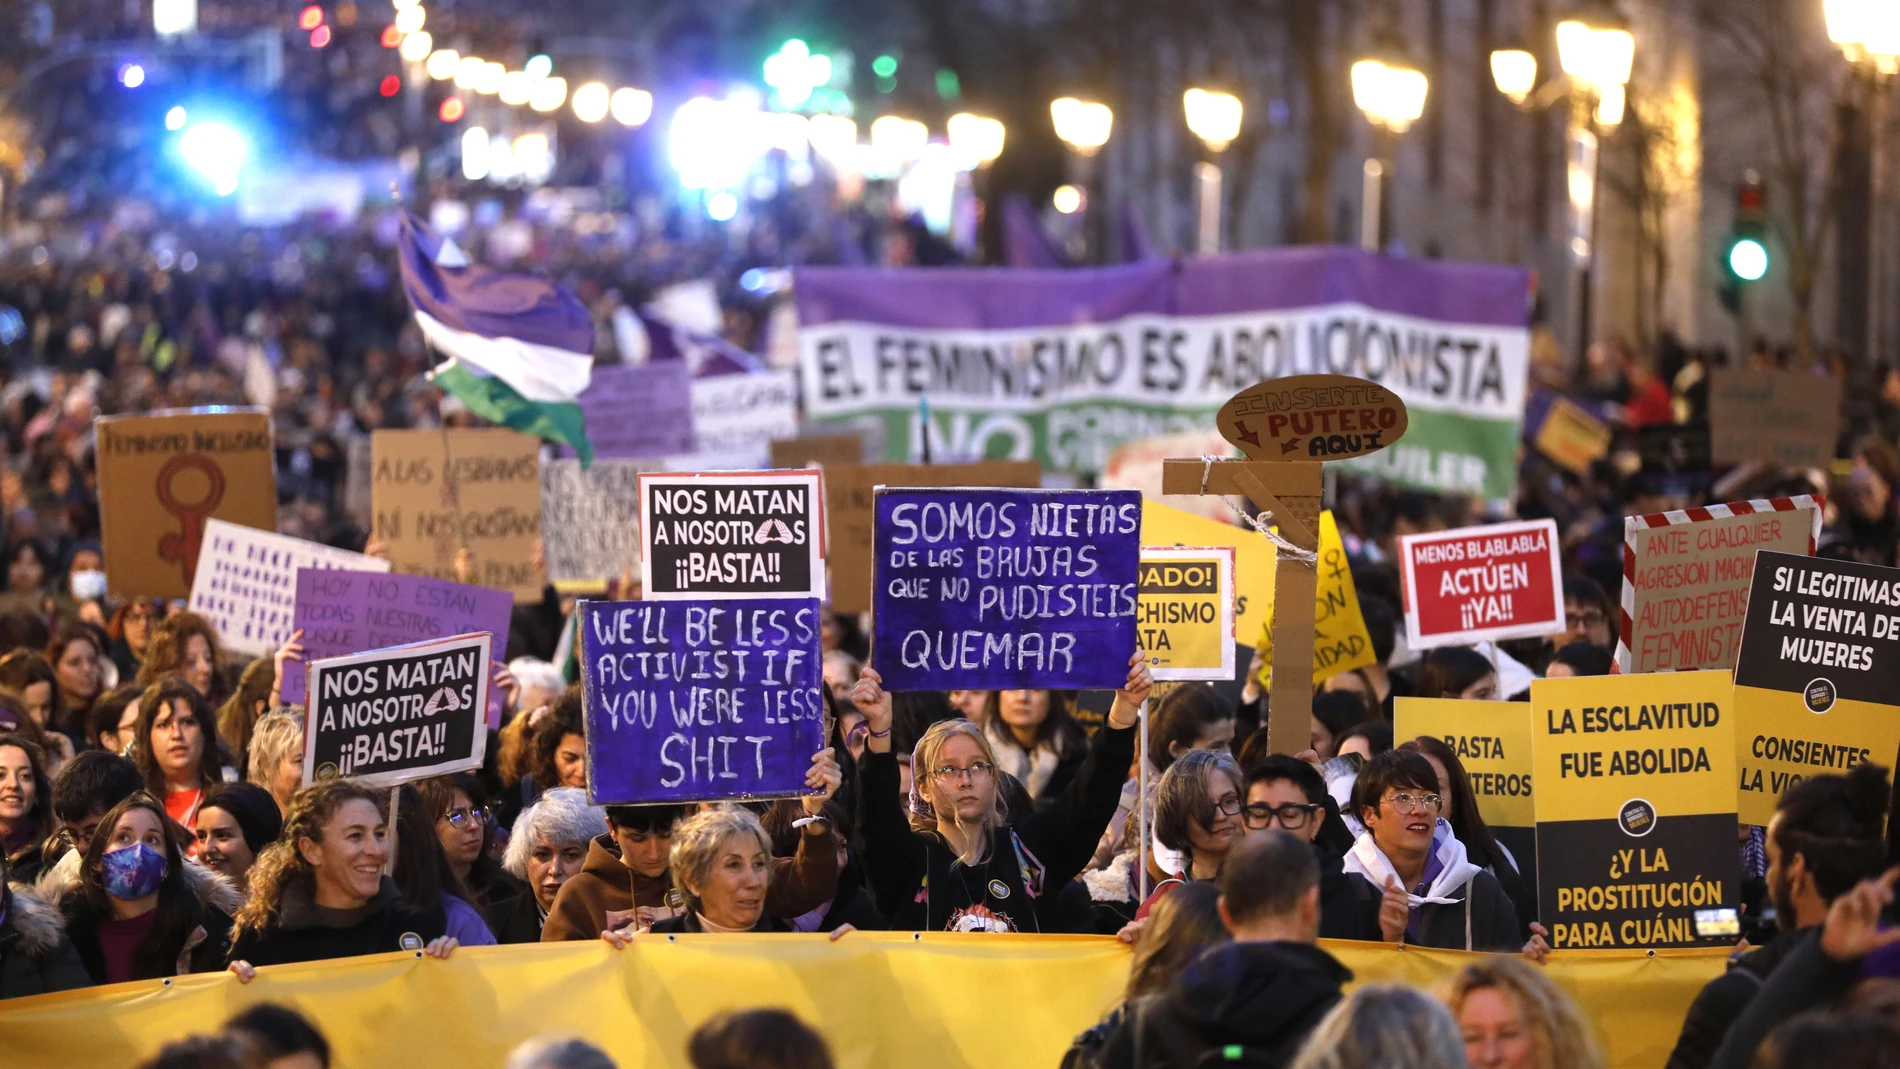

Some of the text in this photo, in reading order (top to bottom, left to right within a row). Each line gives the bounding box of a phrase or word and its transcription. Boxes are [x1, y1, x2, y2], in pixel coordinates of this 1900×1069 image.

[818, 338, 863, 399] EL
[876, 329, 1126, 399] FEMINISMO
[1141, 328, 1189, 391] ES
[1204, 317, 1506, 402] ABOLICIONISTA
[1233, 385, 1384, 416] INSERTE
[1268, 407, 1397, 438] PUTERO
[654, 489, 707, 515] NOS
[715, 489, 804, 515] MATAN
[654, 521, 669, 545] A
[891, 501, 1016, 544] SOMOS
[1647, 520, 1782, 558] ANTE CUALQUIER
[891, 545, 1098, 579] DE LAS BRUJAS
[1415, 530, 1547, 564] MENOS BLABLABLÁ
[676, 552, 781, 588] ¡¡BASTA!!
[1139, 567, 1212, 587] ADO!
[1440, 558, 1528, 597] ACTÚEN
[1773, 566, 1900, 607] SI LEGITIMAS
[312, 577, 353, 598] HOY
[368, 579, 399, 601] NO
[888, 577, 1137, 622] QUE NO PUDISTEIS
[298, 603, 354, 623] TODAS
[366, 606, 440, 635] NUESTRAS
[1461, 594, 1513, 629] ¡¡YA!!
[1638, 587, 1749, 631] AUTODEFENS
[1770, 600, 1900, 640] LA VENTA DE
[593, 606, 813, 648] WE'LL BE LESS
[598, 650, 807, 686] ACTIVIST IF
[901, 629, 1076, 674] QUEMAR
[1780, 636, 1874, 671] MUJERES
[324, 666, 379, 699] NOS
[386, 651, 475, 690] MATAN
[320, 706, 336, 732] A
[602, 686, 821, 731] YOU WERE LESS
[1547, 702, 1720, 735] LA ESCLAVITUD
[339, 722, 447, 775] ¡¡BASTA!!
[660, 732, 773, 788] SHIT
[1444, 735, 1505, 759] BASTA
[1560, 747, 1711, 778] FUE ABOLIDA
[1752, 735, 1870, 770] CONSIENTES
[1739, 767, 1764, 792] LA
[1609, 847, 1669, 879] ¿Y LA
[1557, 875, 1722, 912] PROSTITUCIÓN
[1553, 921, 1615, 948] PARA
